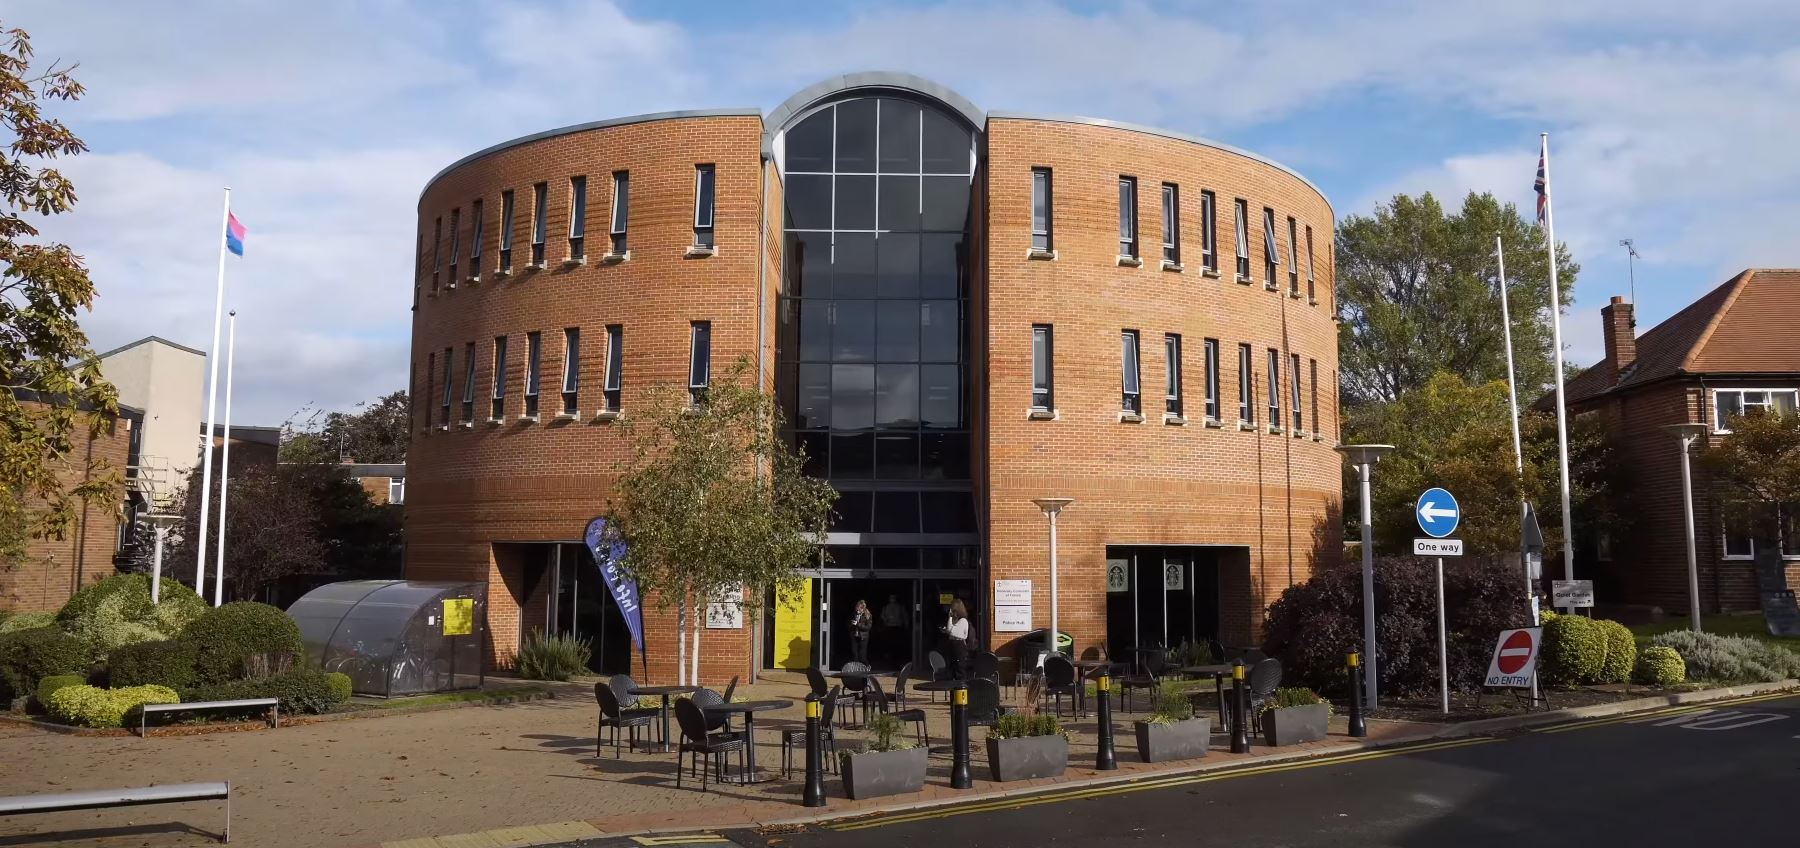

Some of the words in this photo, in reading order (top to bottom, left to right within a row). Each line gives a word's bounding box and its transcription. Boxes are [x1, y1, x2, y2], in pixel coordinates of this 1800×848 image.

[1417, 542, 1437, 551] One
[1440, 544, 1460, 553] way
[1488, 676, 1499, 685] NO
[1500, 676, 1529, 685] ENTRY
